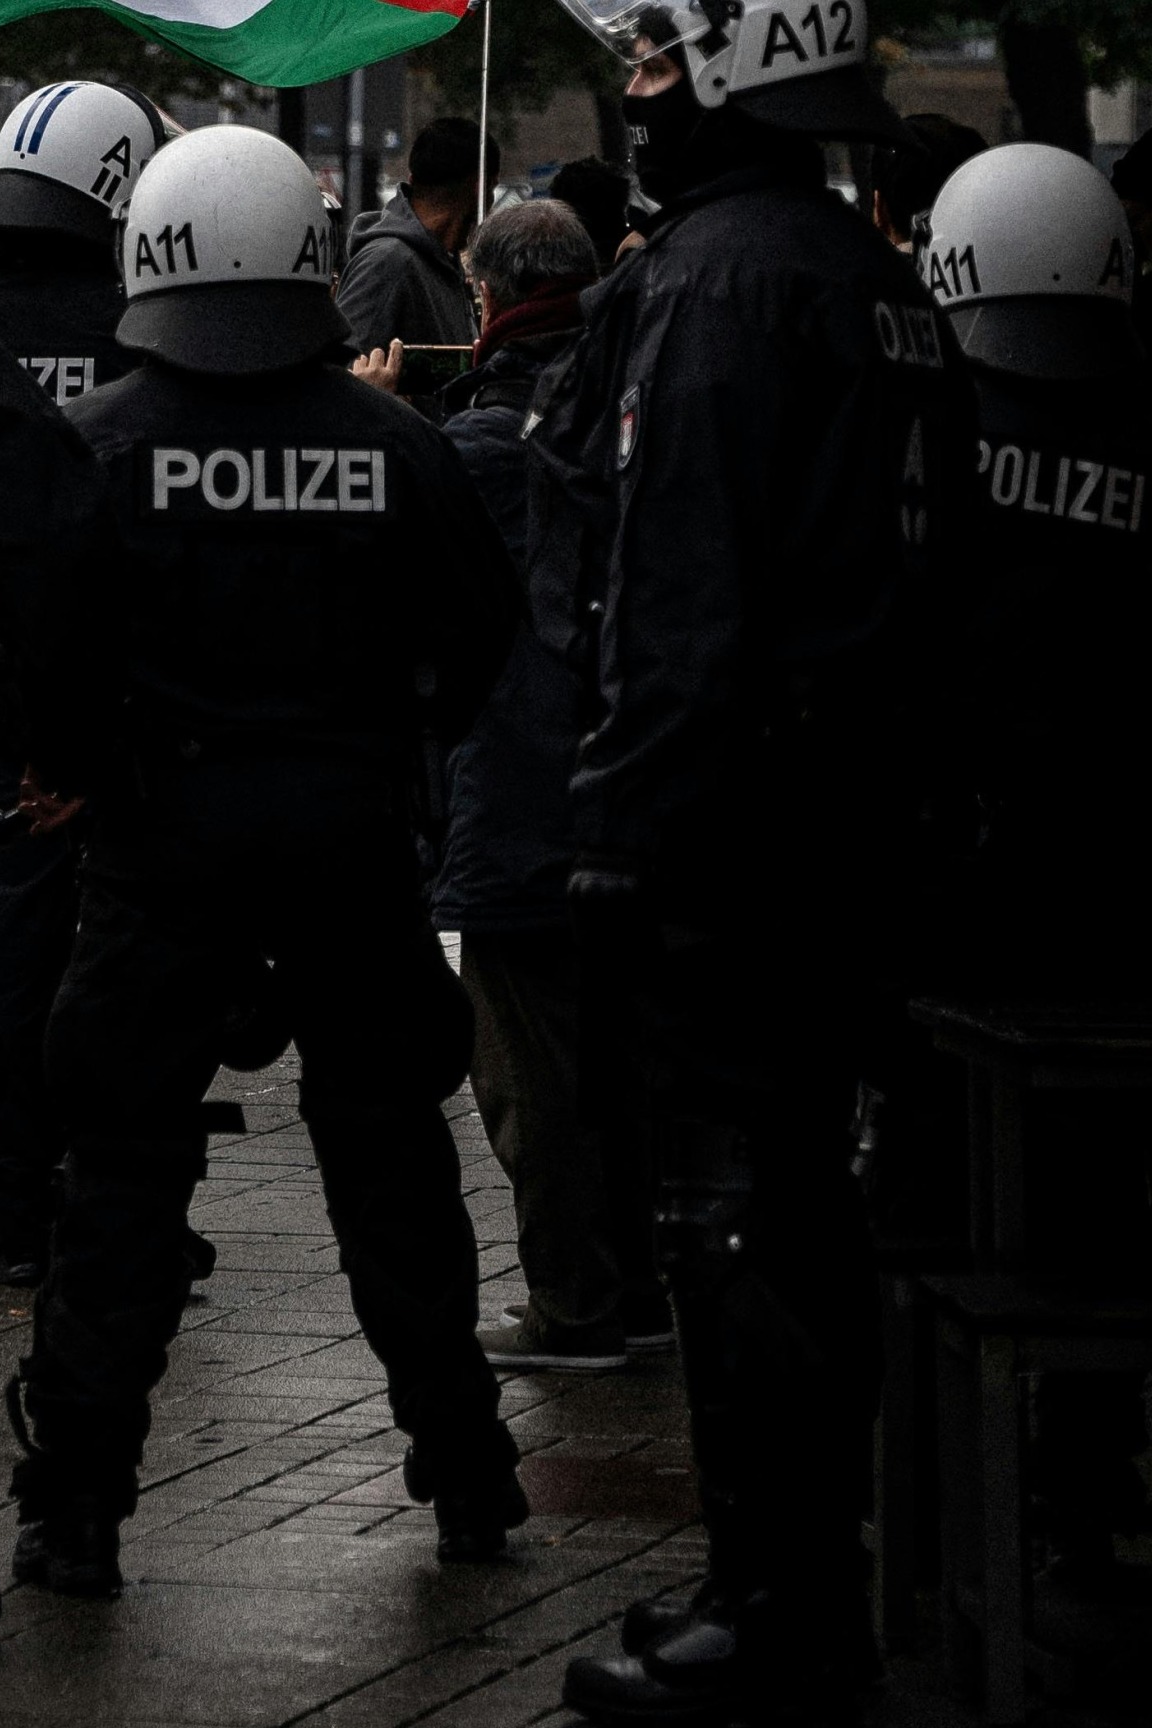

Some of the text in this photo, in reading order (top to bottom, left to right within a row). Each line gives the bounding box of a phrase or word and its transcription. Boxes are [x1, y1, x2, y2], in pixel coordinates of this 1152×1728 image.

[761, 0, 856, 68] A12
[136, 222, 199, 278] A11
[931, 245, 981, 298] A11
[153, 447, 386, 512] POLIZEI
